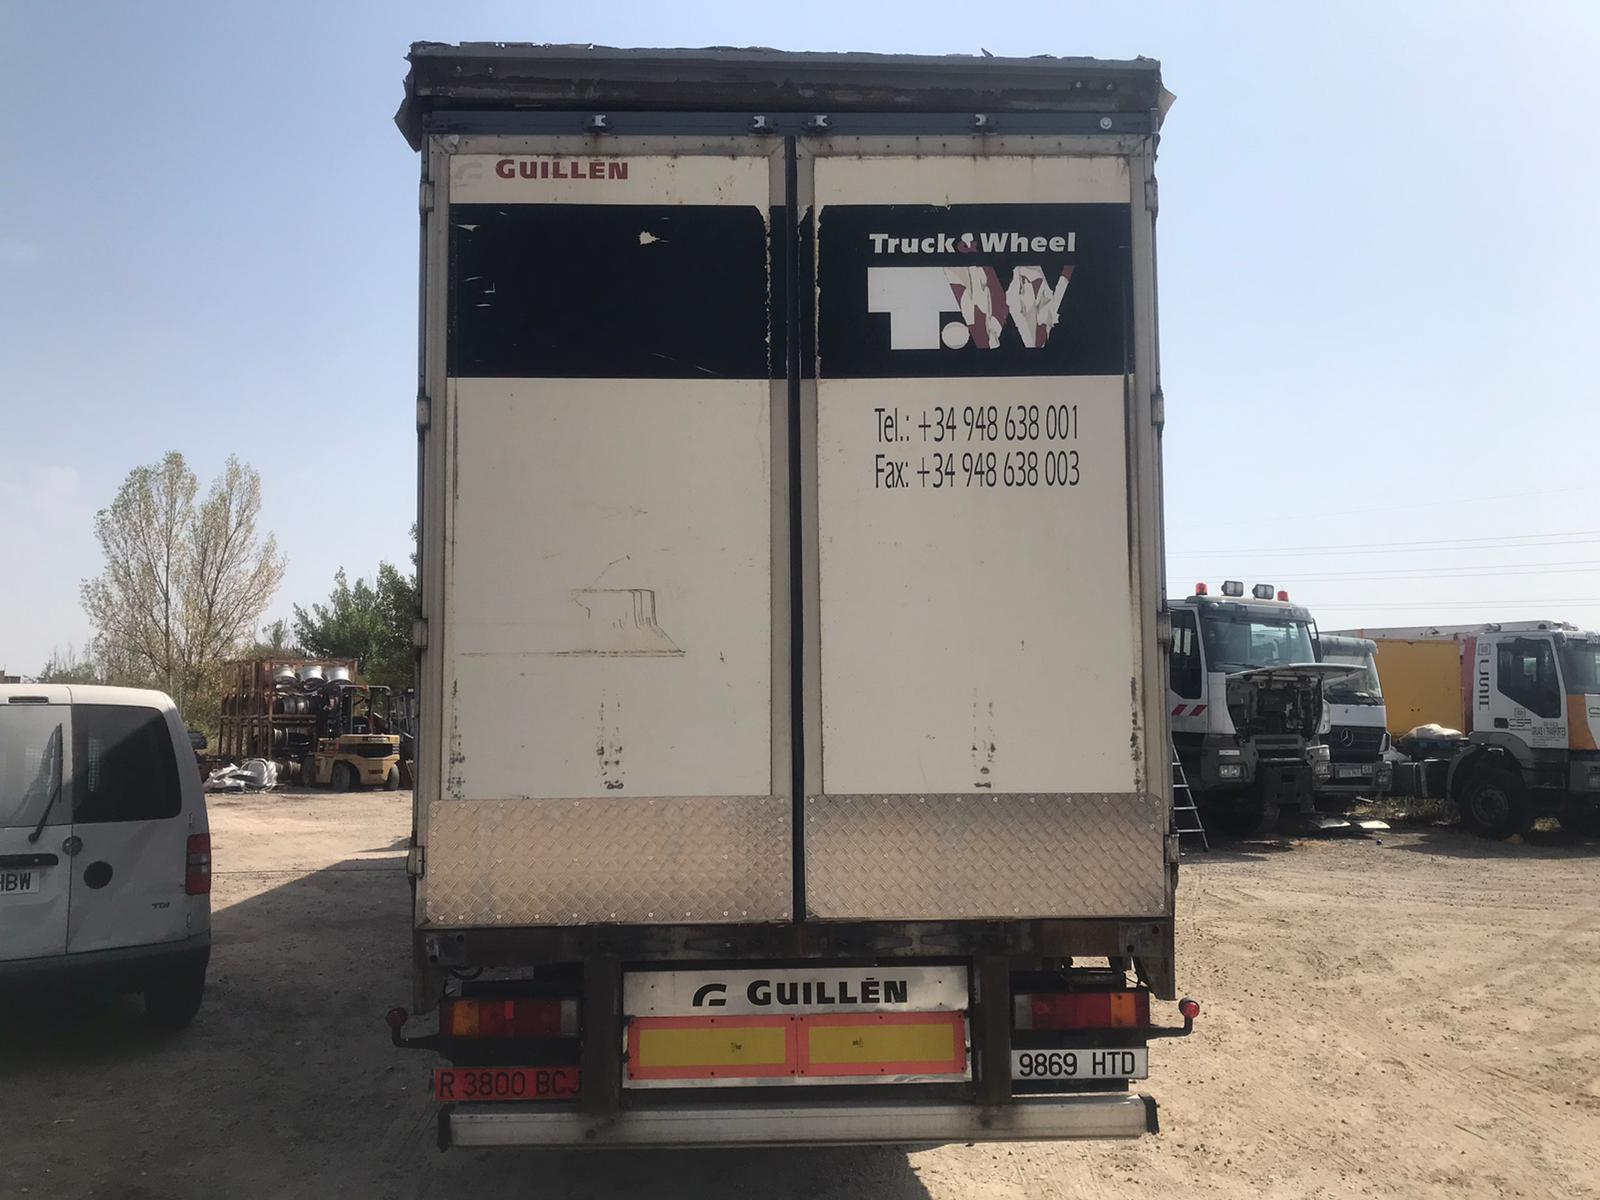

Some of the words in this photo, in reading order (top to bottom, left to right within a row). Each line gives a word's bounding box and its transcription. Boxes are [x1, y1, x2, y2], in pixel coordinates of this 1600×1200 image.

[874, 407, 910, 443] Tel.:
[918, 406, 957, 443] +34
[963, 405, 998, 442] 948
[1004, 405, 1040, 441] 638
[1046, 405, 1079, 440] 001
[875, 453, 909, 489] Fax:
[917, 452, 956, 488] +34
[962, 451, 997, 488] 948
[1003, 450, 1039, 487] 638
[1045, 450, 1080, 486] 003
[1019, 1052, 1078, 1076] 9869
[1092, 1051, 1136, 1076] HTD
[439, 1071, 456, 1097] R
[463, 1071, 526, 1097] 3800
